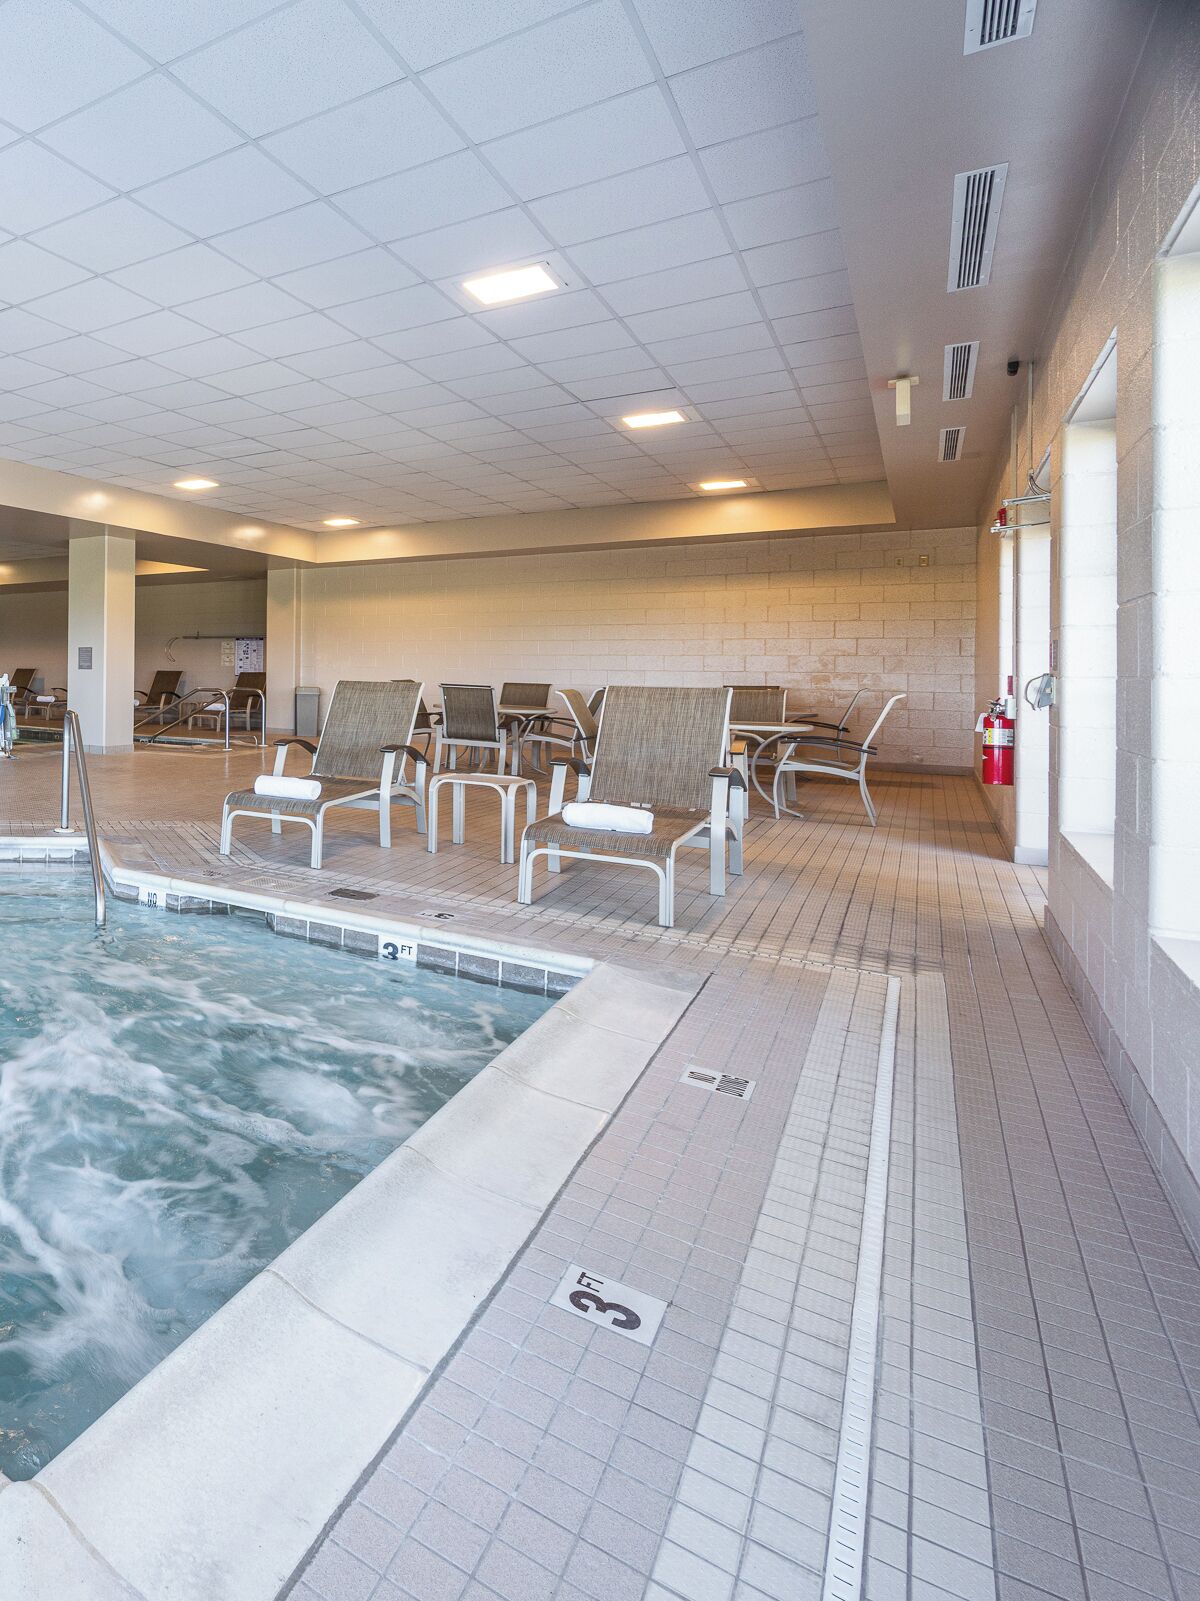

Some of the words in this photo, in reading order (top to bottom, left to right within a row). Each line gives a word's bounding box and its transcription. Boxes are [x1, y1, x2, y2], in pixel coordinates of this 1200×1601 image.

[147, 892, 158, 904] NO
[382, 942, 399, 960] 3
[401, 944, 413, 956] FT
[576, 1271, 604, 1293] FT
[568, 1290, 642, 1330] 3
